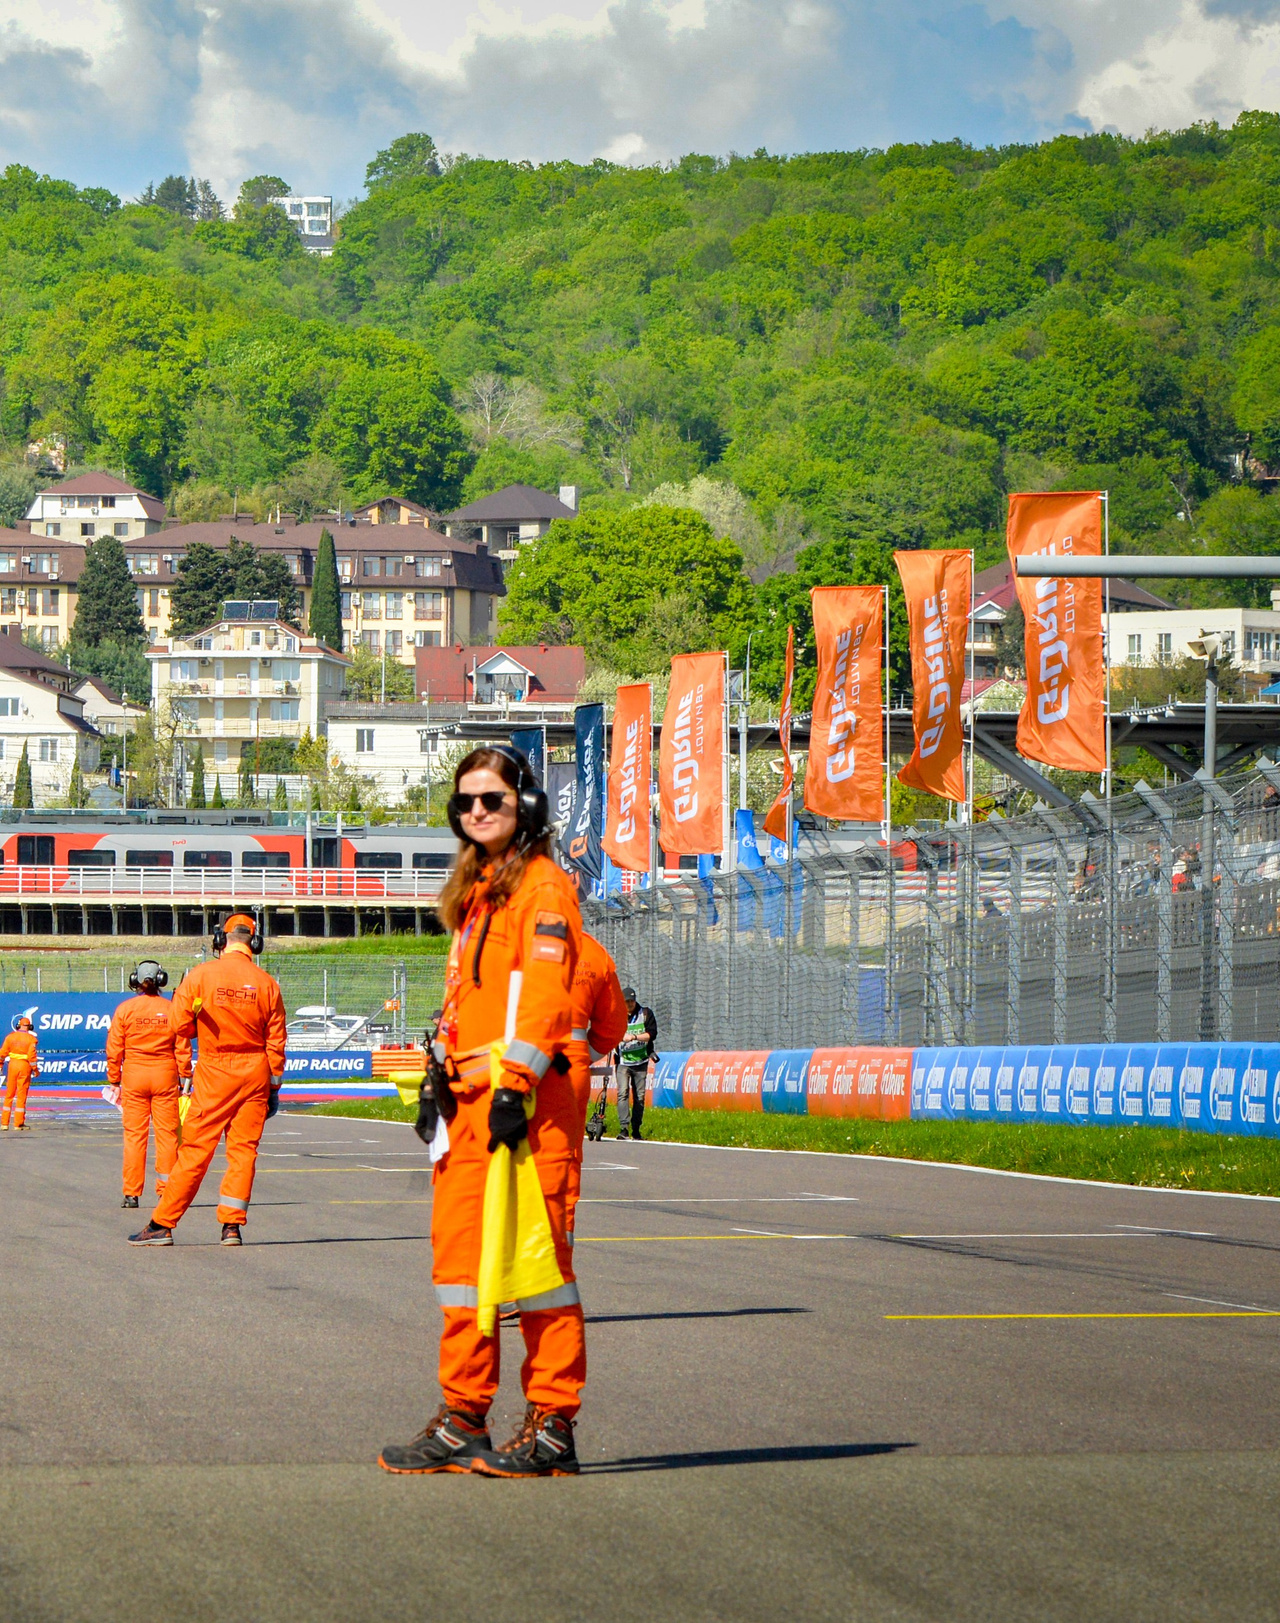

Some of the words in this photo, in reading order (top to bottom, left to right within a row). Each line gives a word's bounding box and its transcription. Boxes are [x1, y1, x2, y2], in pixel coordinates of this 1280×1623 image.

[216, 987, 257, 1000] SOCHI
[38, 1013, 81, 1030] SMP
[135, 1017, 168, 1025] SOCHI
[36, 1060, 67, 1073] SMP
[68, 1060, 111, 1073] RACIN
[283, 1058, 309, 1071] MP
[310, 1058, 365, 1071] RACING
